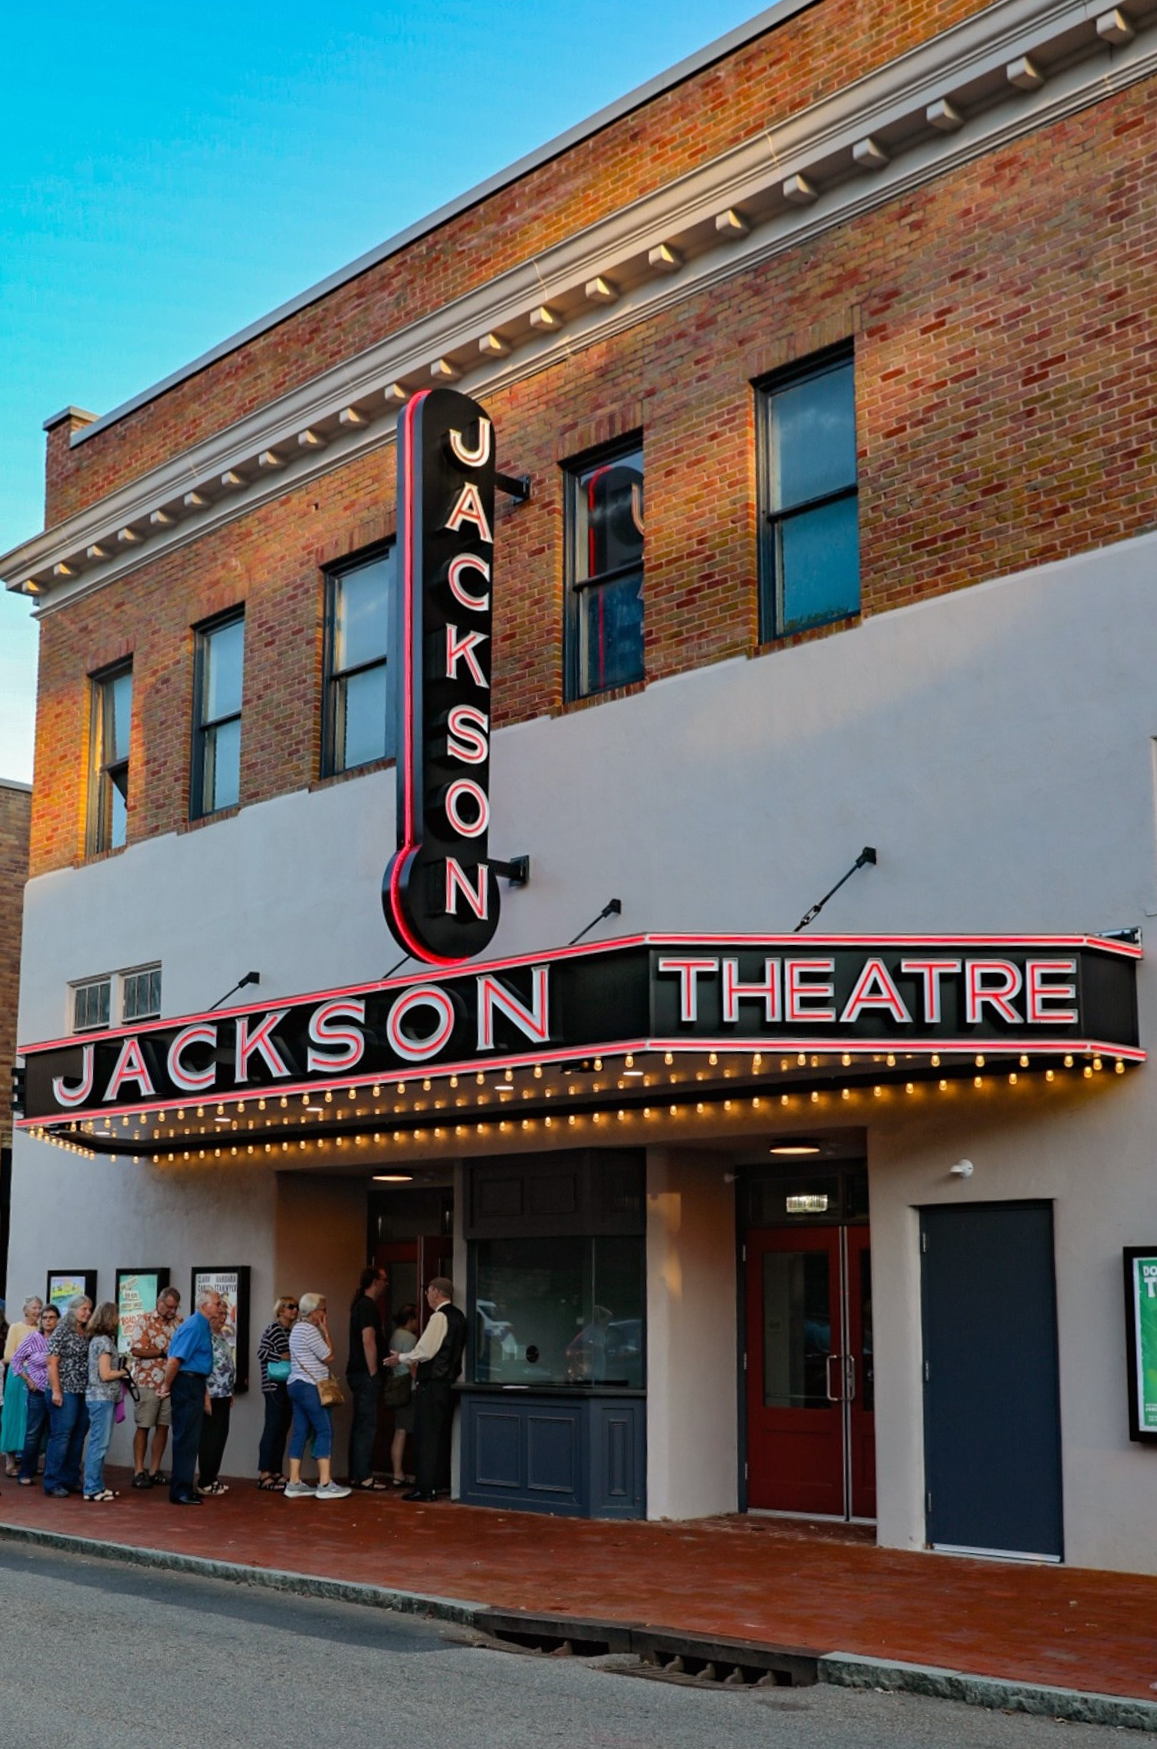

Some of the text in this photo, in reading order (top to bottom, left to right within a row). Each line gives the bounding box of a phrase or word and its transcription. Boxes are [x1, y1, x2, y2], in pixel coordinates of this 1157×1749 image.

[444, 416, 492, 920] JACKSON
[52, 957, 1079, 1107] JACKSON THEATRE
